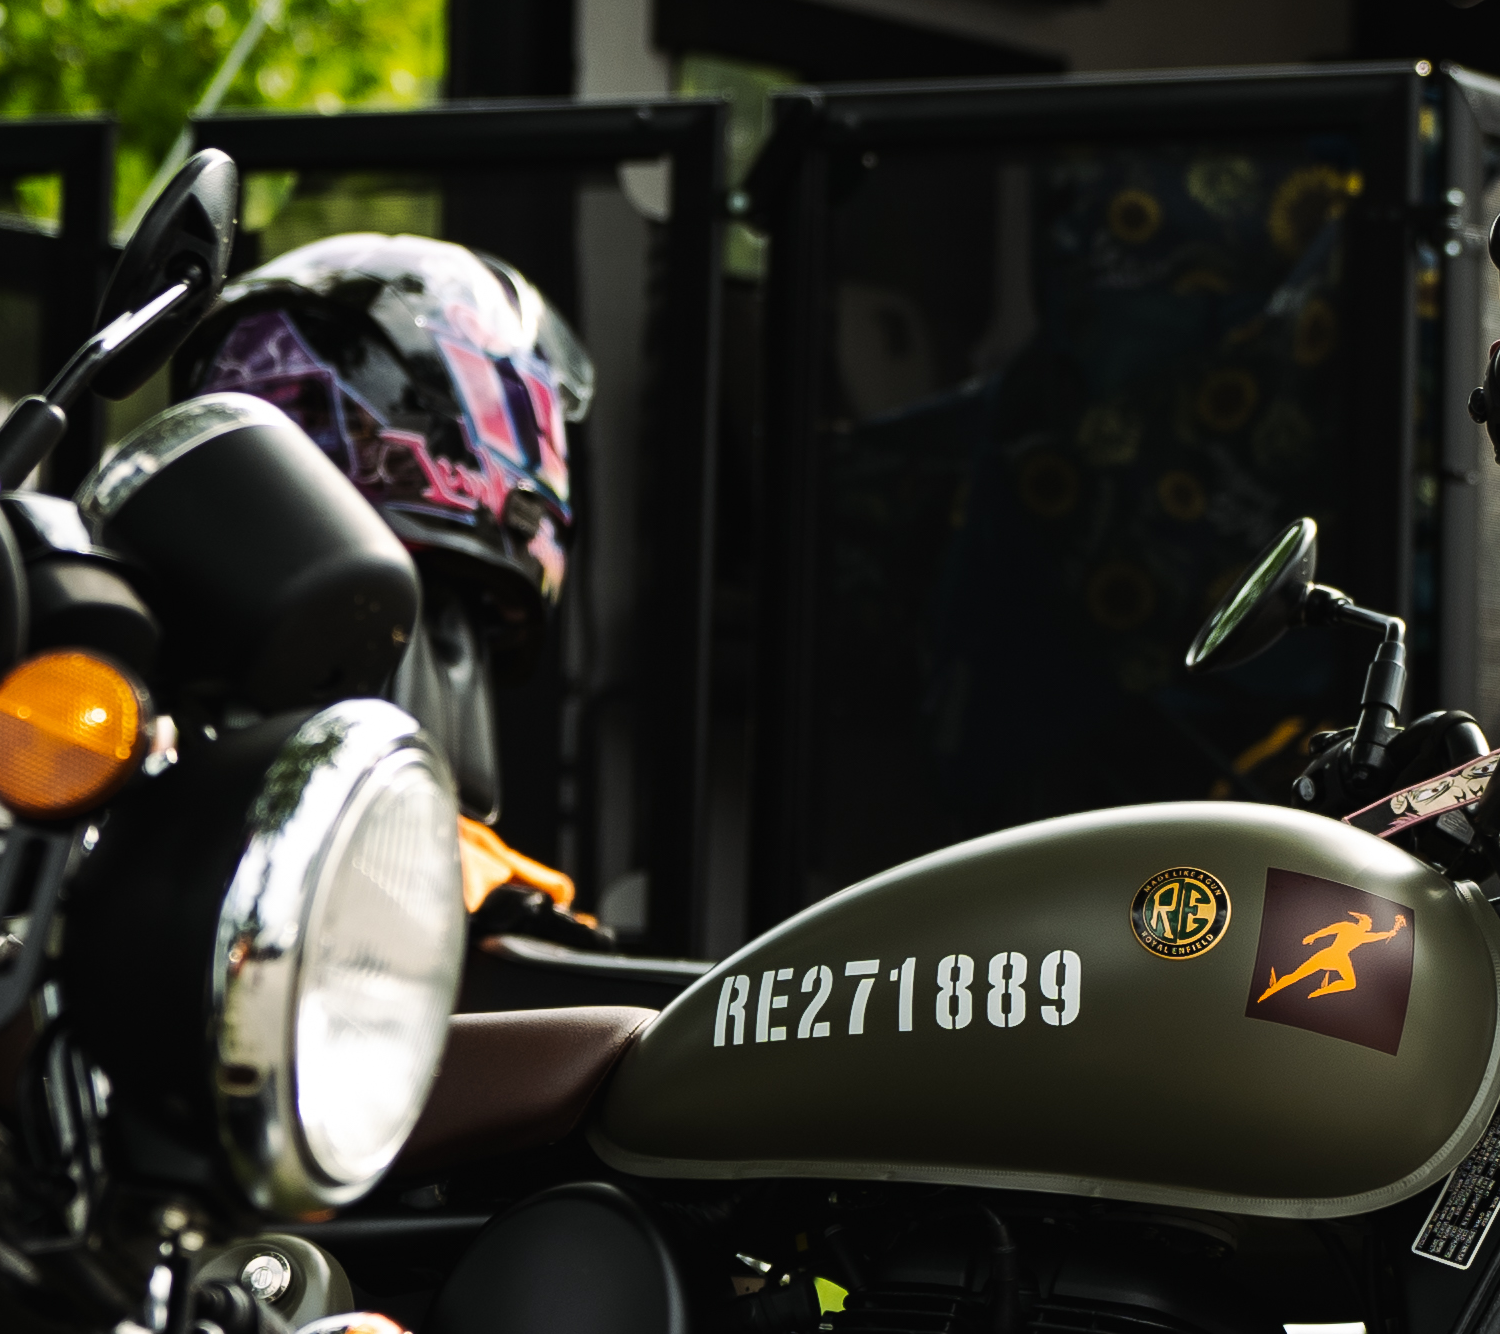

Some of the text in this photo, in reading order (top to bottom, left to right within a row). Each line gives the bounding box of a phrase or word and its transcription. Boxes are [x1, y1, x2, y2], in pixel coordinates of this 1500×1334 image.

[1144, 873, 1169, 893] MADE
[1173, 870, 1197, 878] LIKE
[1205, 878, 1223, 896] GUN
[1150, 882, 1212, 940] RE
[1141, 930, 1215, 955] ROYAL ENFIELD
[711, 948, 1084, 1049] RE271889
